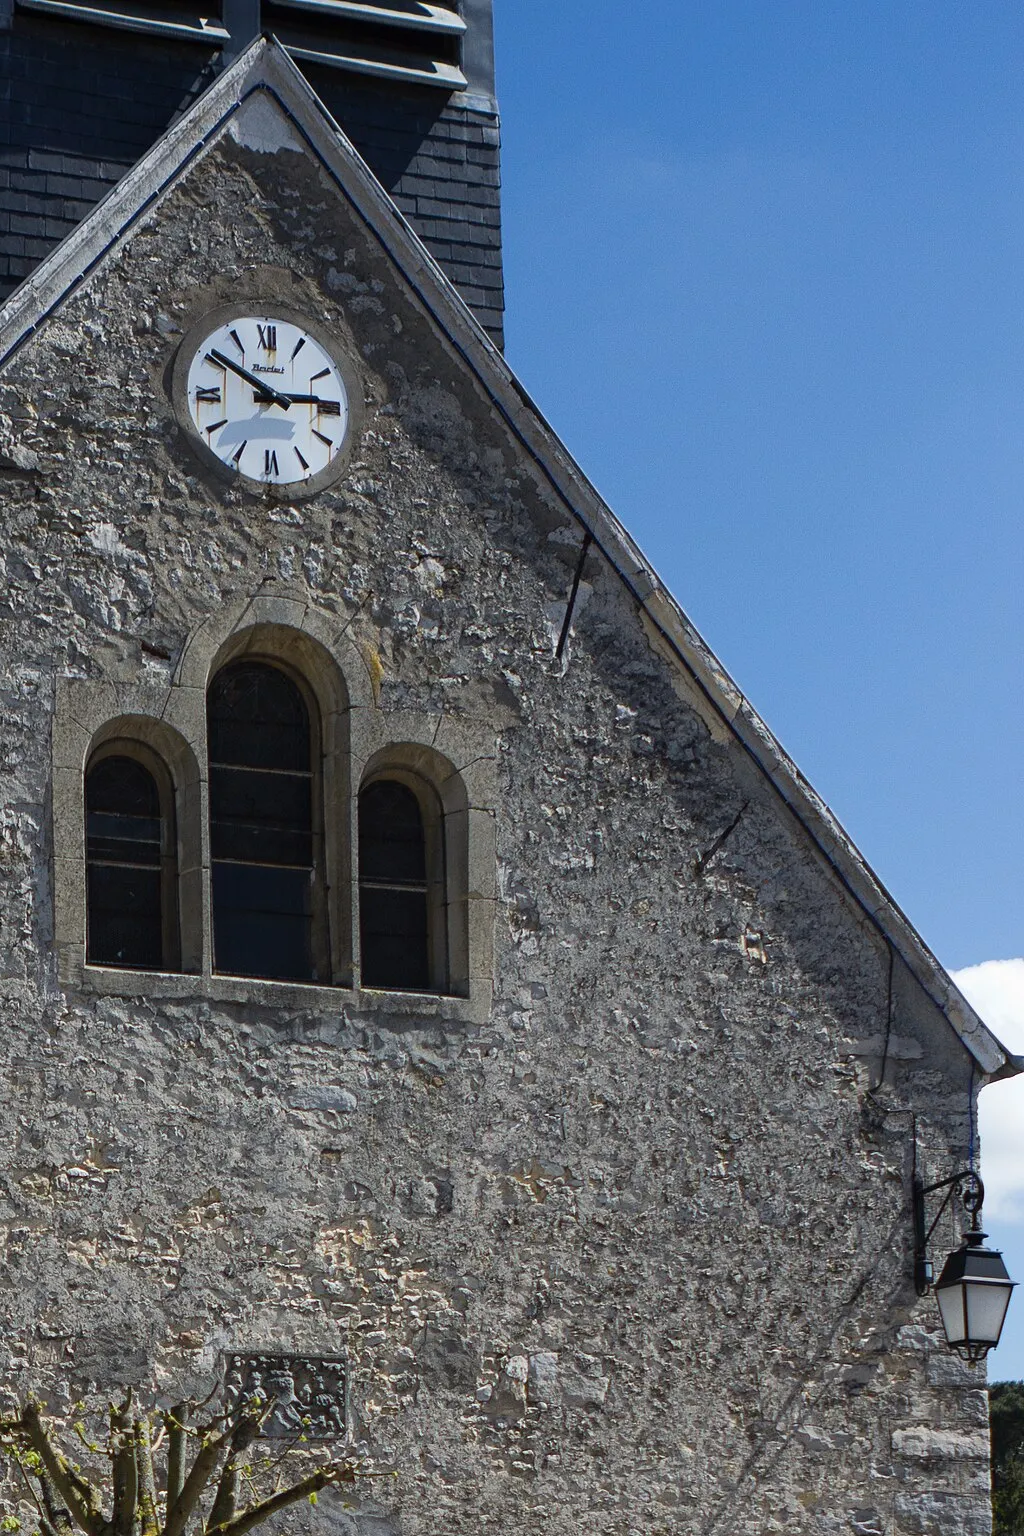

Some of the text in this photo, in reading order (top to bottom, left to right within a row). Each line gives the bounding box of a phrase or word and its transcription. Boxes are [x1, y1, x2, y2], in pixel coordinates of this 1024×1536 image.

[256, 324, 277, 351] XII
[251, 363, 285, 375] Bodet
[195, 385, 221, 403] IX
[264, 449, 280, 476] VI
